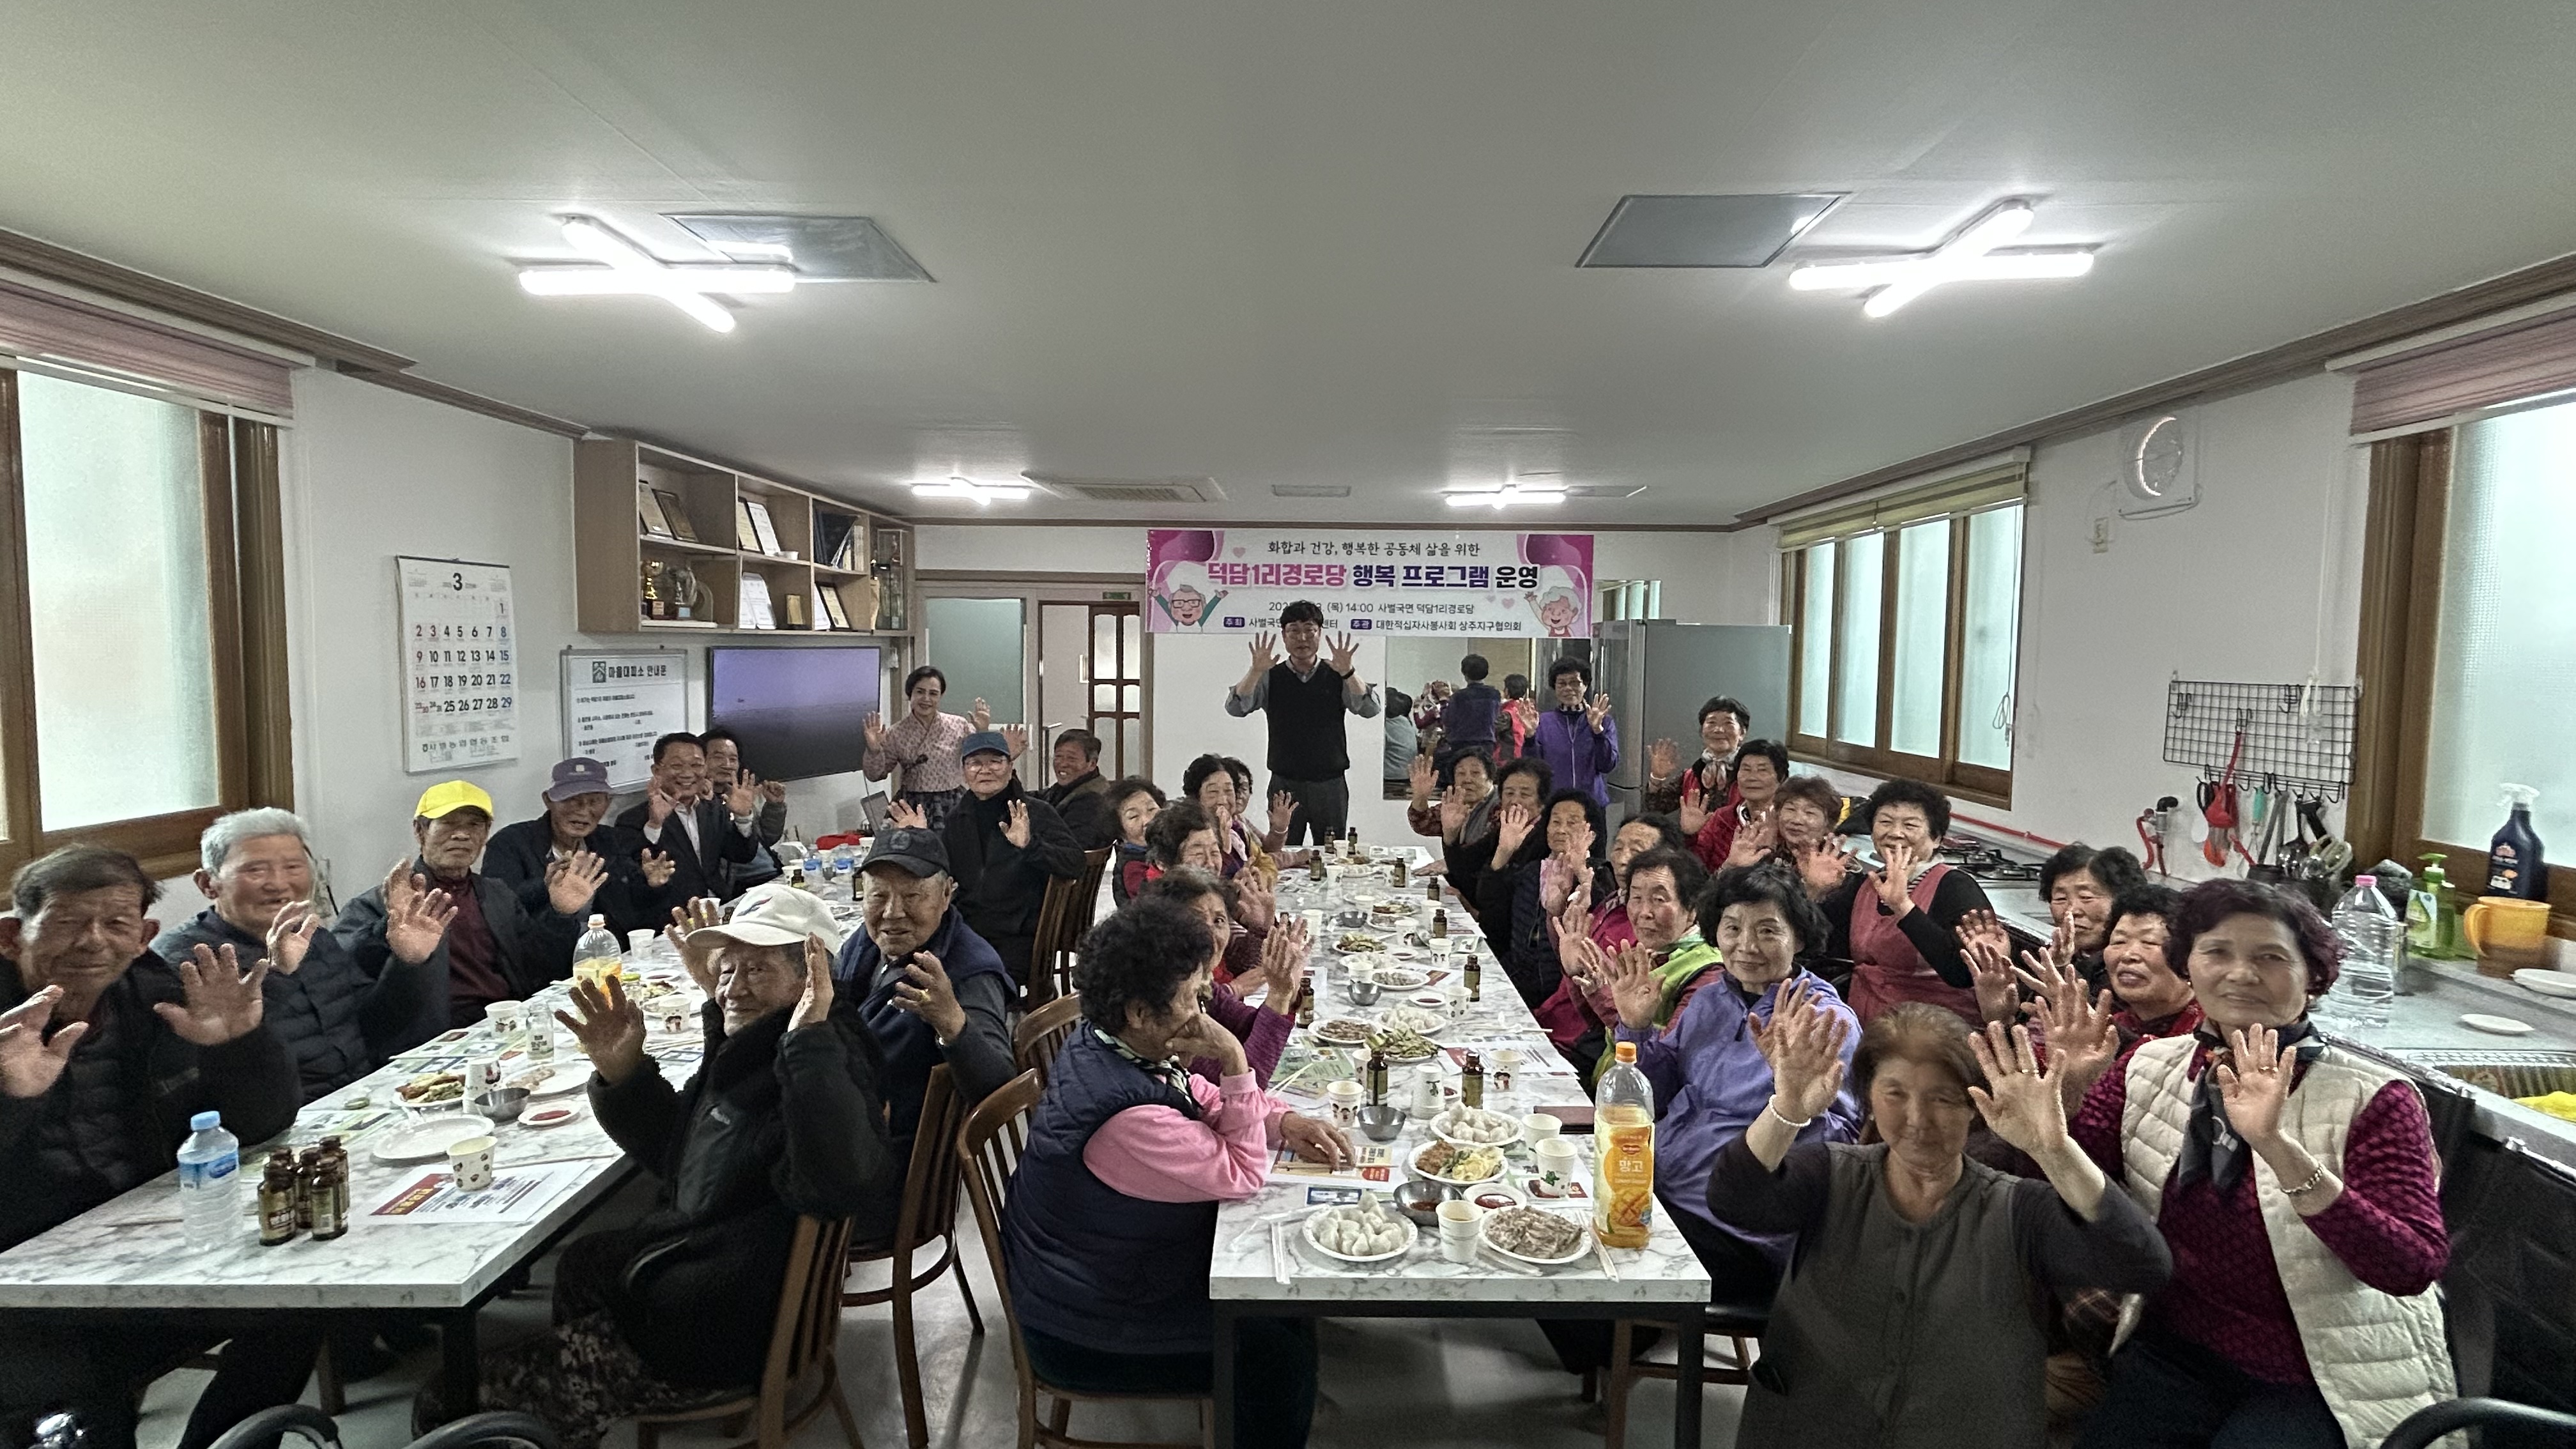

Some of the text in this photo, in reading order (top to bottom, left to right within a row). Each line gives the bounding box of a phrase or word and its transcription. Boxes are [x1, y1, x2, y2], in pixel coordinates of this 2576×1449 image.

[1268, 540, 1480, 557] 화합과 건강, 행복한 공동체 삶을 위한
[452, 572, 463, 591] 3
[1208, 562, 1538, 589] 덕담1리경로당 행복 프로그램 운영
[499, 602, 504, 614] 1
[1345, 603, 1374, 613] 14:00
[1377, 602, 1414, 613] 사벌국면
[1416, 603, 1475, 615] 덕담1리경로당
[416, 624, 507, 638] 2 3 4 5 6 7 8
[1376, 619, 1456, 631] 대한적십자사봉사회
[1459, 620, 1522, 631] 상주지구협의회
[417, 650, 509, 663] 9 10 11 12 13 14 15
[415, 673, 511, 689] 16 17 18 19 20 21 22
[444, 700, 456, 713] 25
[458, 700, 470, 712] 26
[472, 698, 483, 710] 27
[486, 697, 498, 709] 28
[501, 696, 512, 709] 29
[1619, 1159, 1644, 1173] 망고
